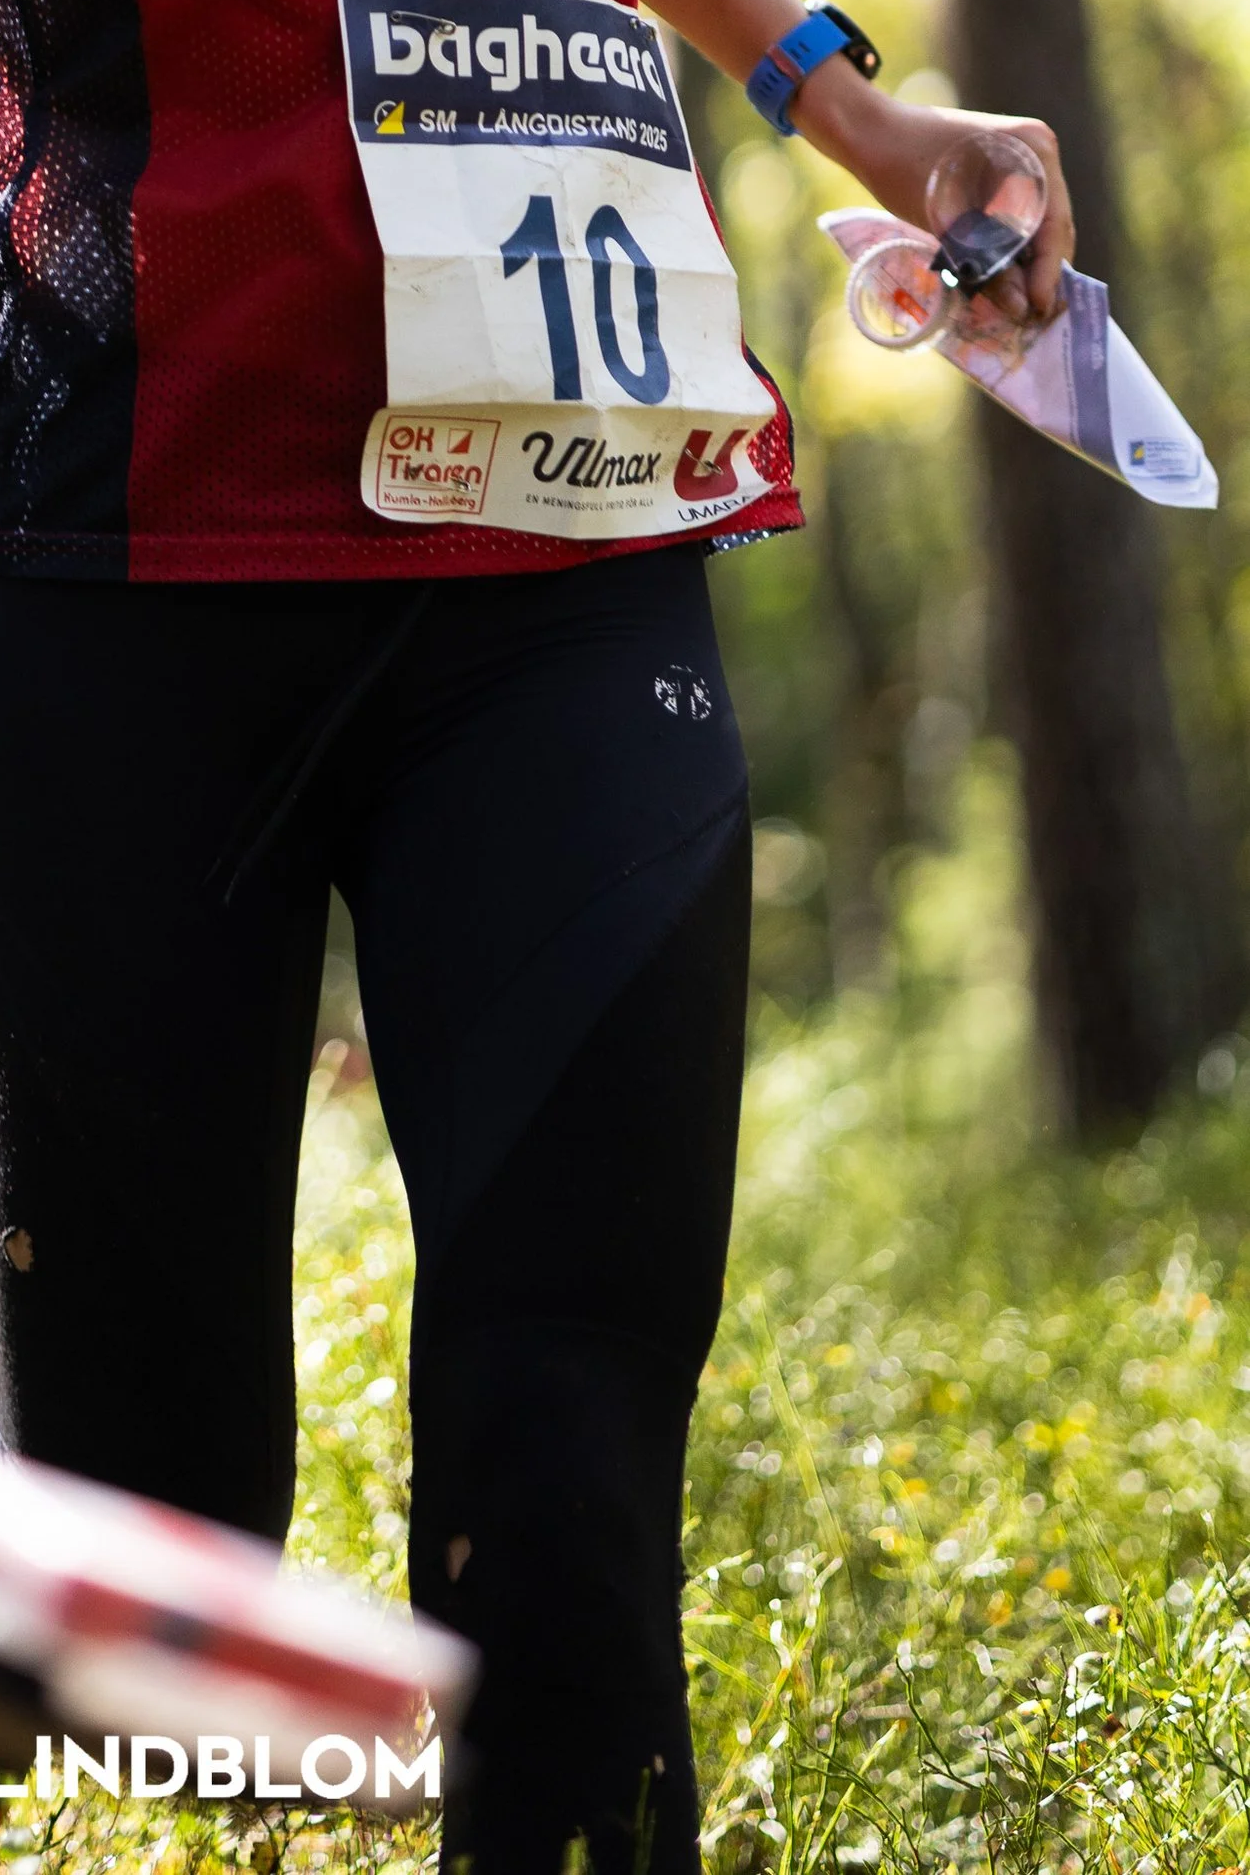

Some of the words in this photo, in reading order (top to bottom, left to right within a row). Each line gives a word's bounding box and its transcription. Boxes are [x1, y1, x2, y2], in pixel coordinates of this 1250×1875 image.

[369, 12, 666, 102] bagheera
[419, 109, 457, 133] SM
[478, 107, 637, 143] LÅNGDISTANS
[639, 124, 668, 153] 2025
[499, 195, 671, 405] 10
